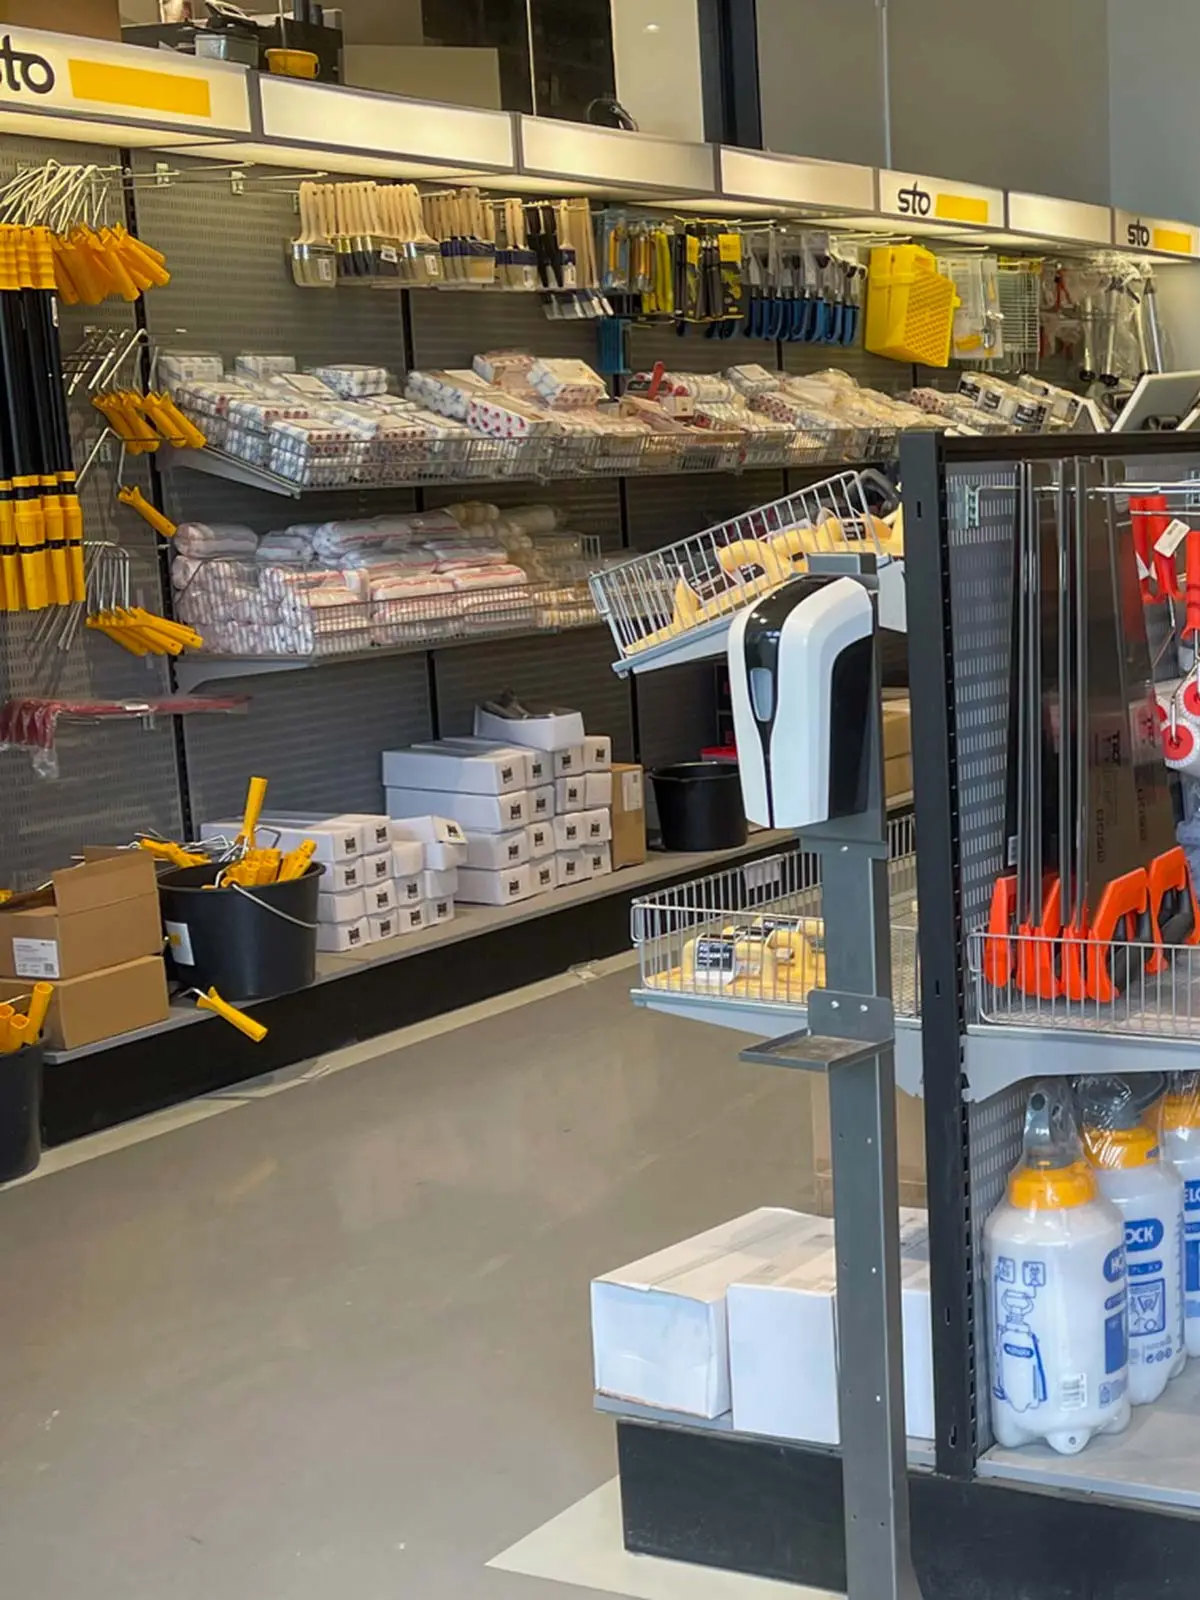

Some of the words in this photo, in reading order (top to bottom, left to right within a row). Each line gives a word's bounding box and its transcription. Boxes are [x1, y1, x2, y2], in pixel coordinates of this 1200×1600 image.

[0, 34, 55, 95] to
[897, 181, 931, 216] sto
[1127, 219, 1150, 247] sto
